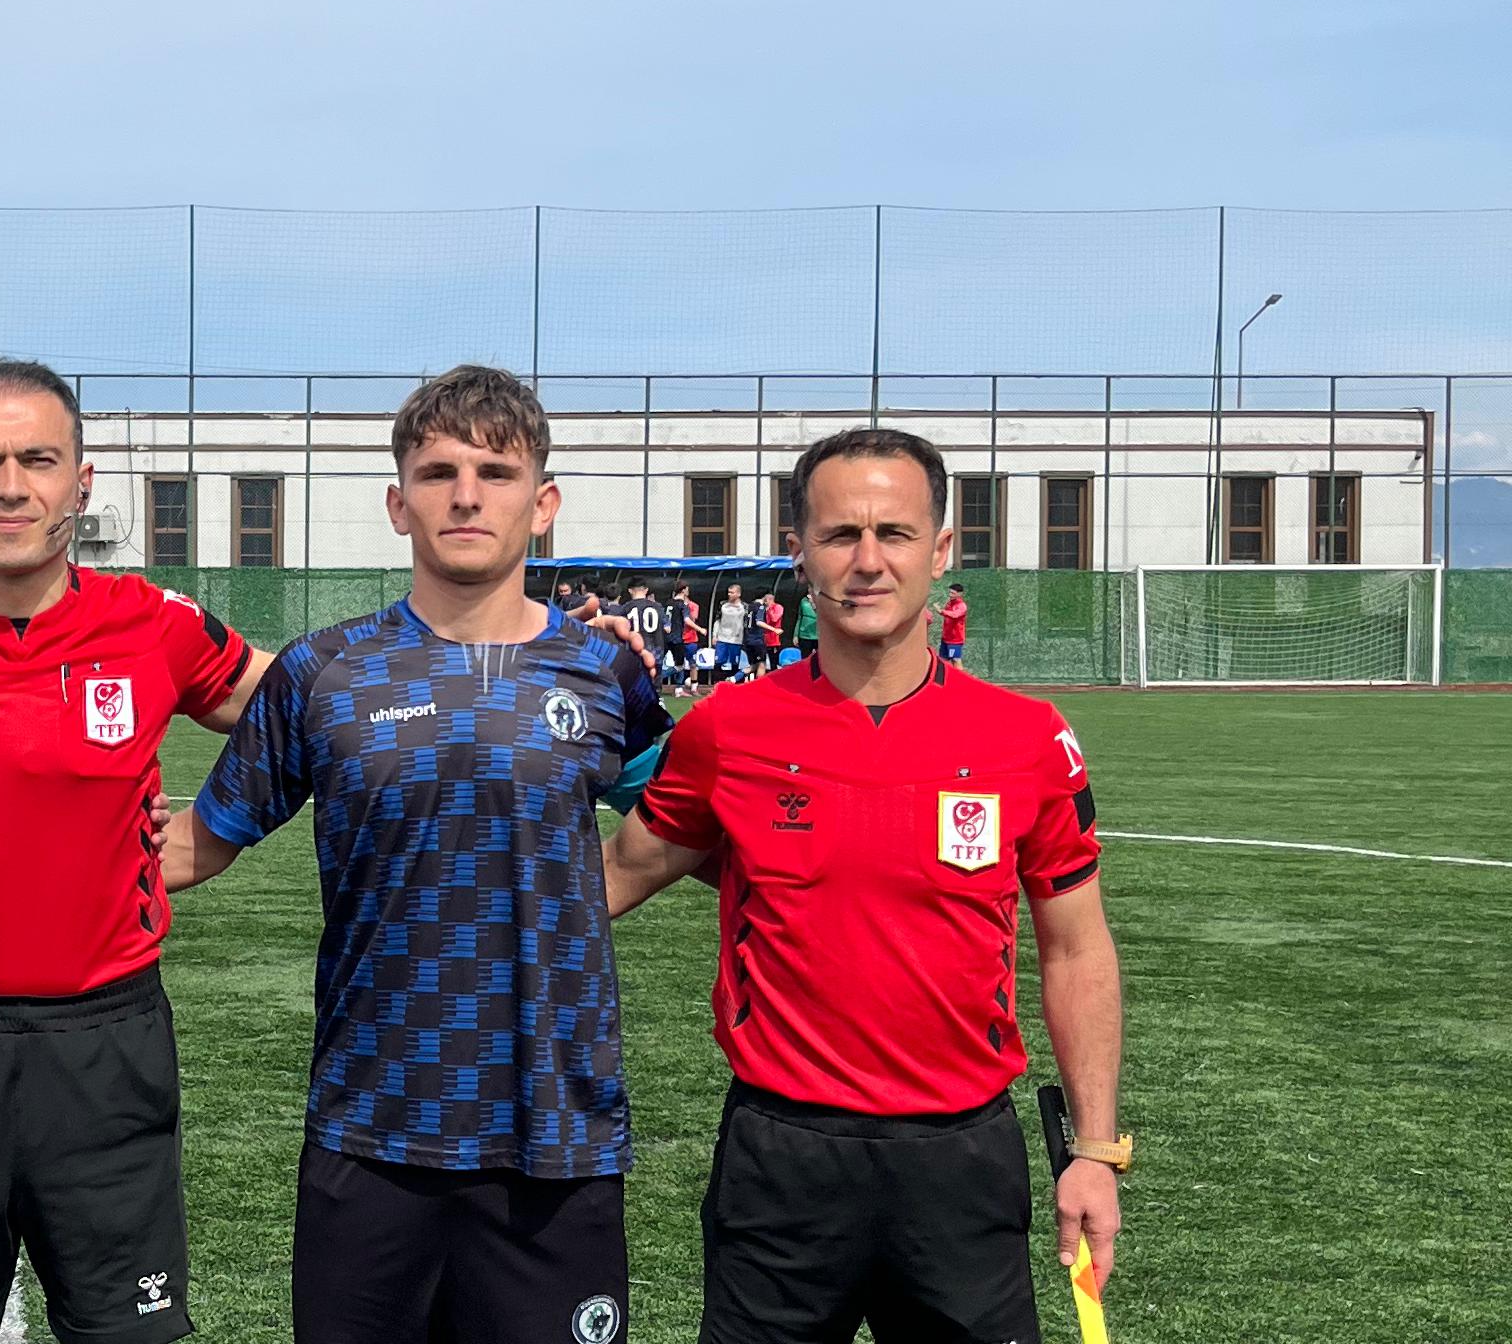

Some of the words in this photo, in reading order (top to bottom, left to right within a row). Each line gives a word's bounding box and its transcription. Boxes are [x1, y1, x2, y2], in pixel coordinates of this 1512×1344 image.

[627, 607, 659, 633] 10
[369, 702, 437, 723] uhlsport
[95, 724, 126, 738] TFF
[951, 845, 987, 861] TFF
